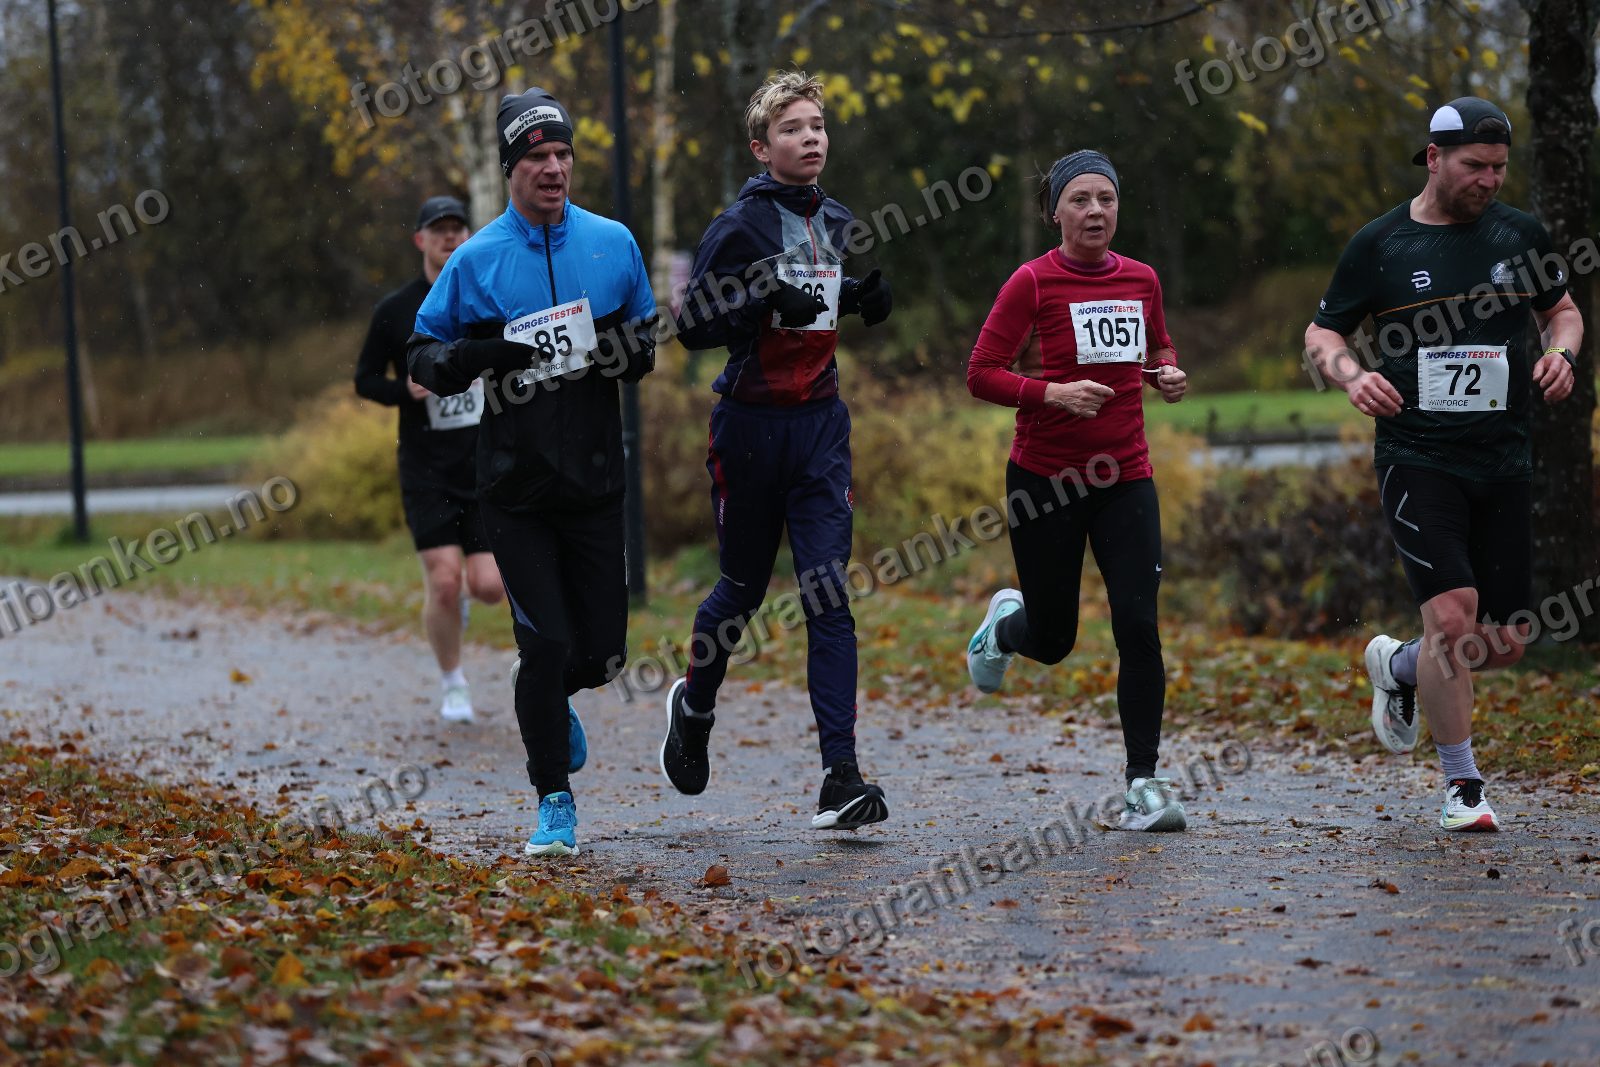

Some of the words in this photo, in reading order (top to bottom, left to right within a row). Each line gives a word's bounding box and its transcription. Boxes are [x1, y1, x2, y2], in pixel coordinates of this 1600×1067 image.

[509, 113, 558, 140] Sportslager
[518, 109, 538, 122] Oslo
[784, 269, 837, 279] NORGESTESTEN
[509, 304, 584, 336] NORGESTESTEN
[1077, 305, 1139, 316] NORGESTESTEN
[534, 324, 573, 364] 85
[1082, 317, 1140, 348] 1057
[1424, 351, 1501, 360] NORGESTESTEN
[1445, 363, 1481, 396] 72
[436, 391, 476, 418] 228
[1428, 399, 1469, 407] WINFORCE
